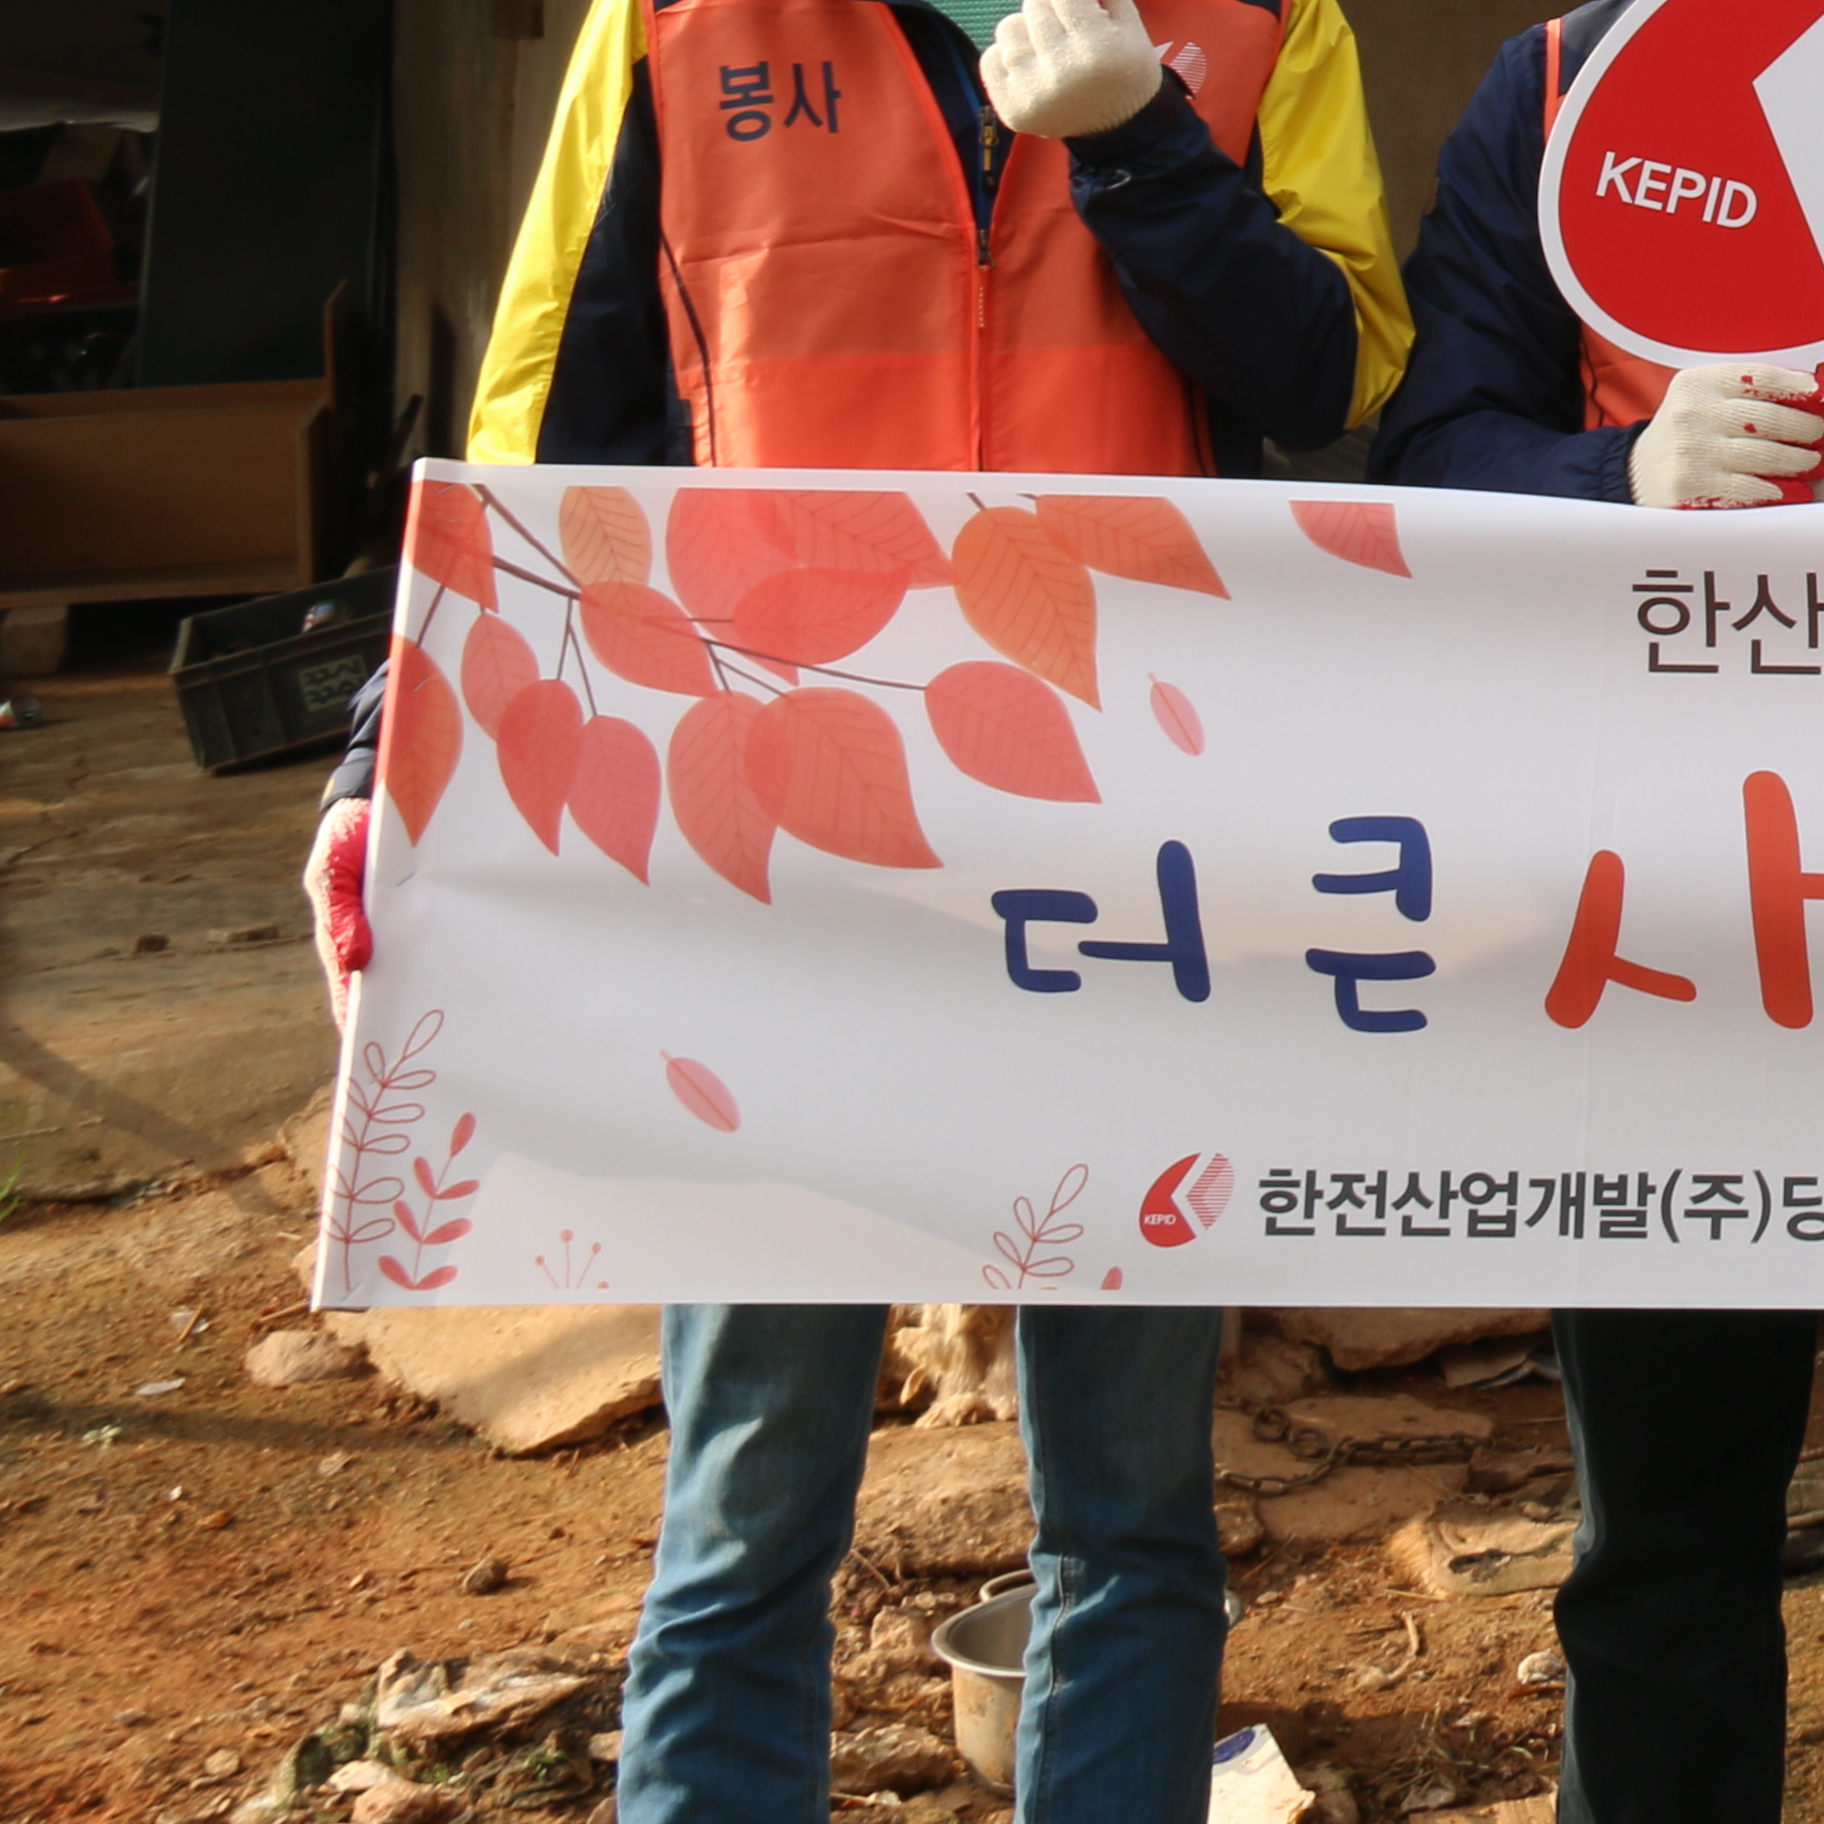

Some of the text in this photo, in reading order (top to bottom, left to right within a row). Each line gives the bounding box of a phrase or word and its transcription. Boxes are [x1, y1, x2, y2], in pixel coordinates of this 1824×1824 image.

[719, 61, 842, 142] 봉사
[1596, 150, 1758, 229] KEPID
[991, 840, 1211, 1003] 더
[1304, 816, 1436, 1033] 큰
[1144, 1214, 1176, 1226] KEPID
